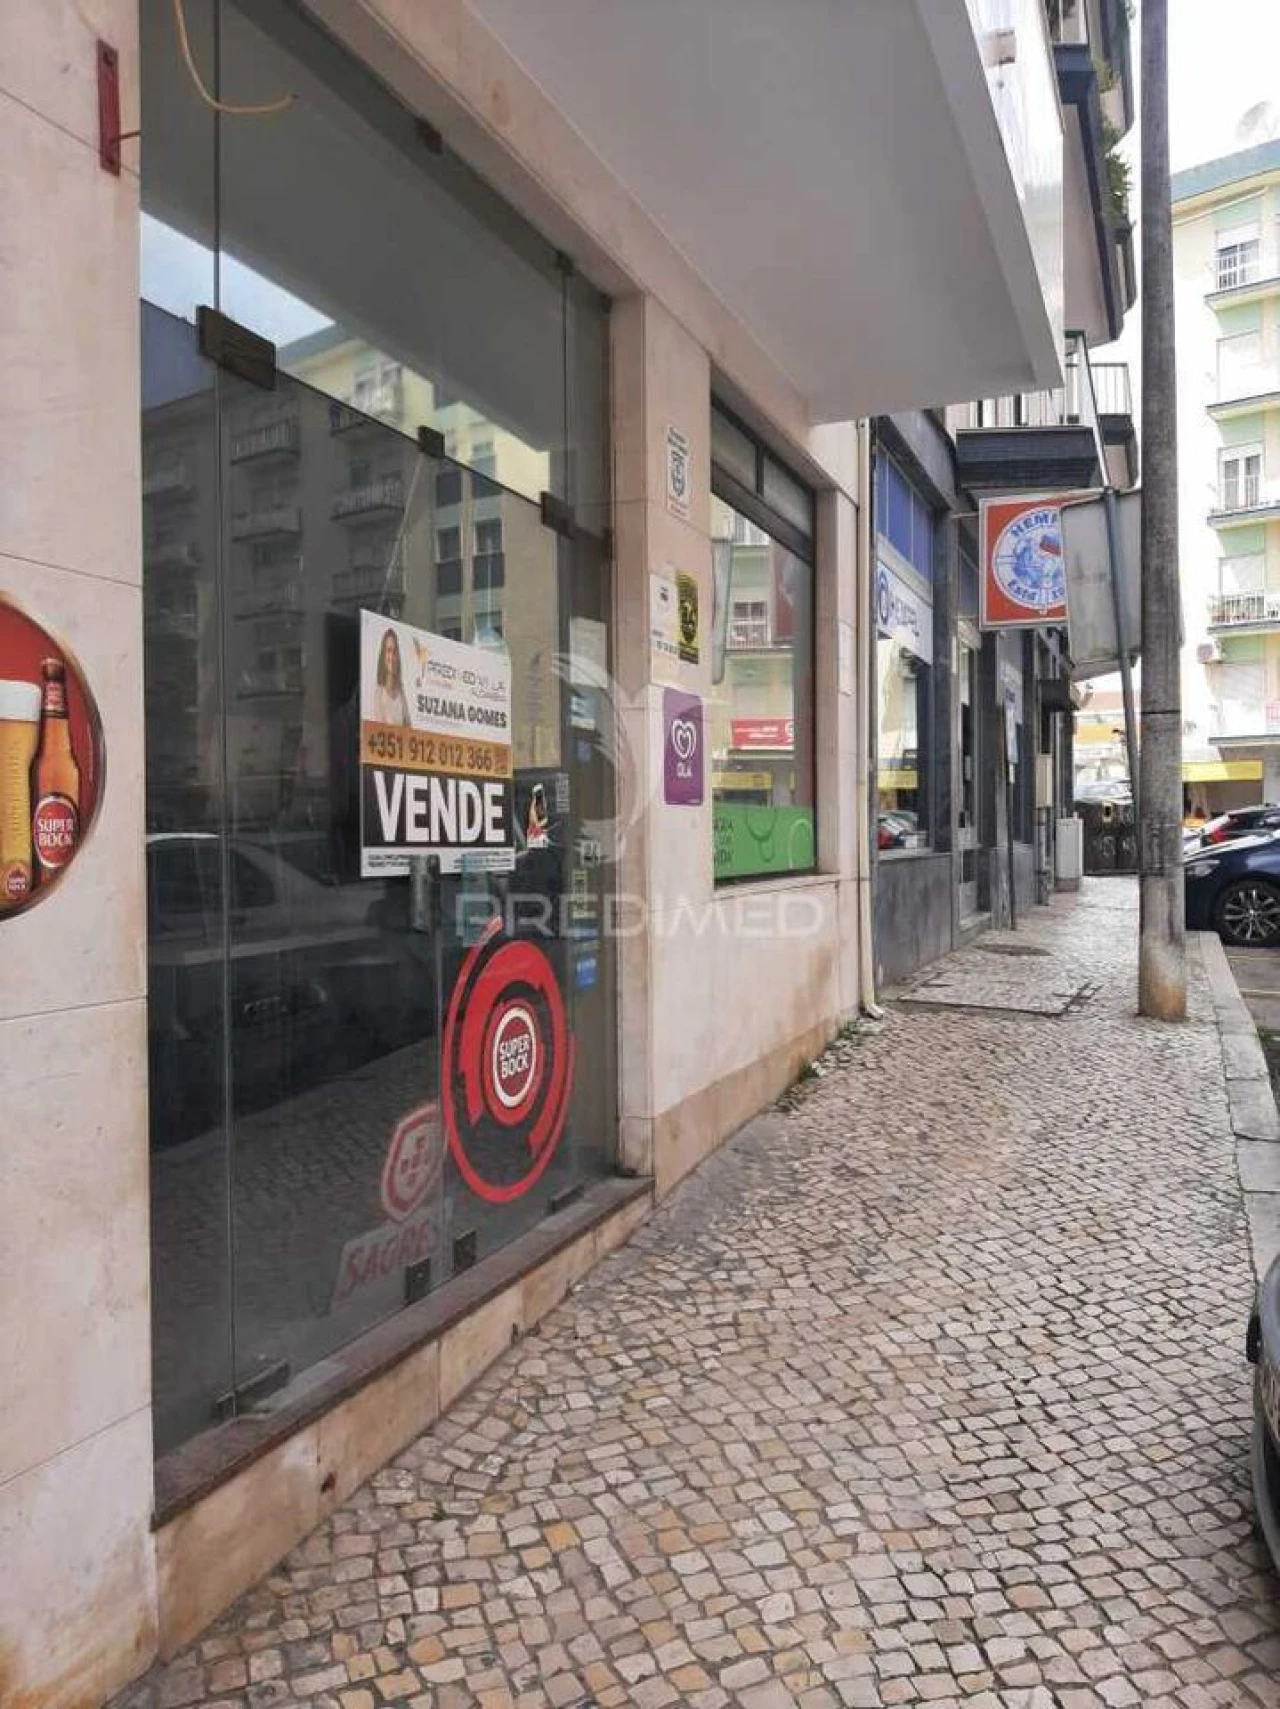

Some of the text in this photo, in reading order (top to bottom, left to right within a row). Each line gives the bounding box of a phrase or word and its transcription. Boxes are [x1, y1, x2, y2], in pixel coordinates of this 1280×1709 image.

[417, 693, 465, 720] SUZANA
[468, 705, 506, 728] GOMES
[367, 731, 403, 759] +351
[408, 736, 436, 764] 912
[439, 741, 464, 768] 012
[467, 745, 493, 772] 366
[373, 770, 506, 843] VENDE
[37, 817, 74, 832] SUPER
[38, 831, 73, 847] BOCK
[500, 1034, 530, 1060] SUPER
[501, 1052, 530, 1079] BOCK
